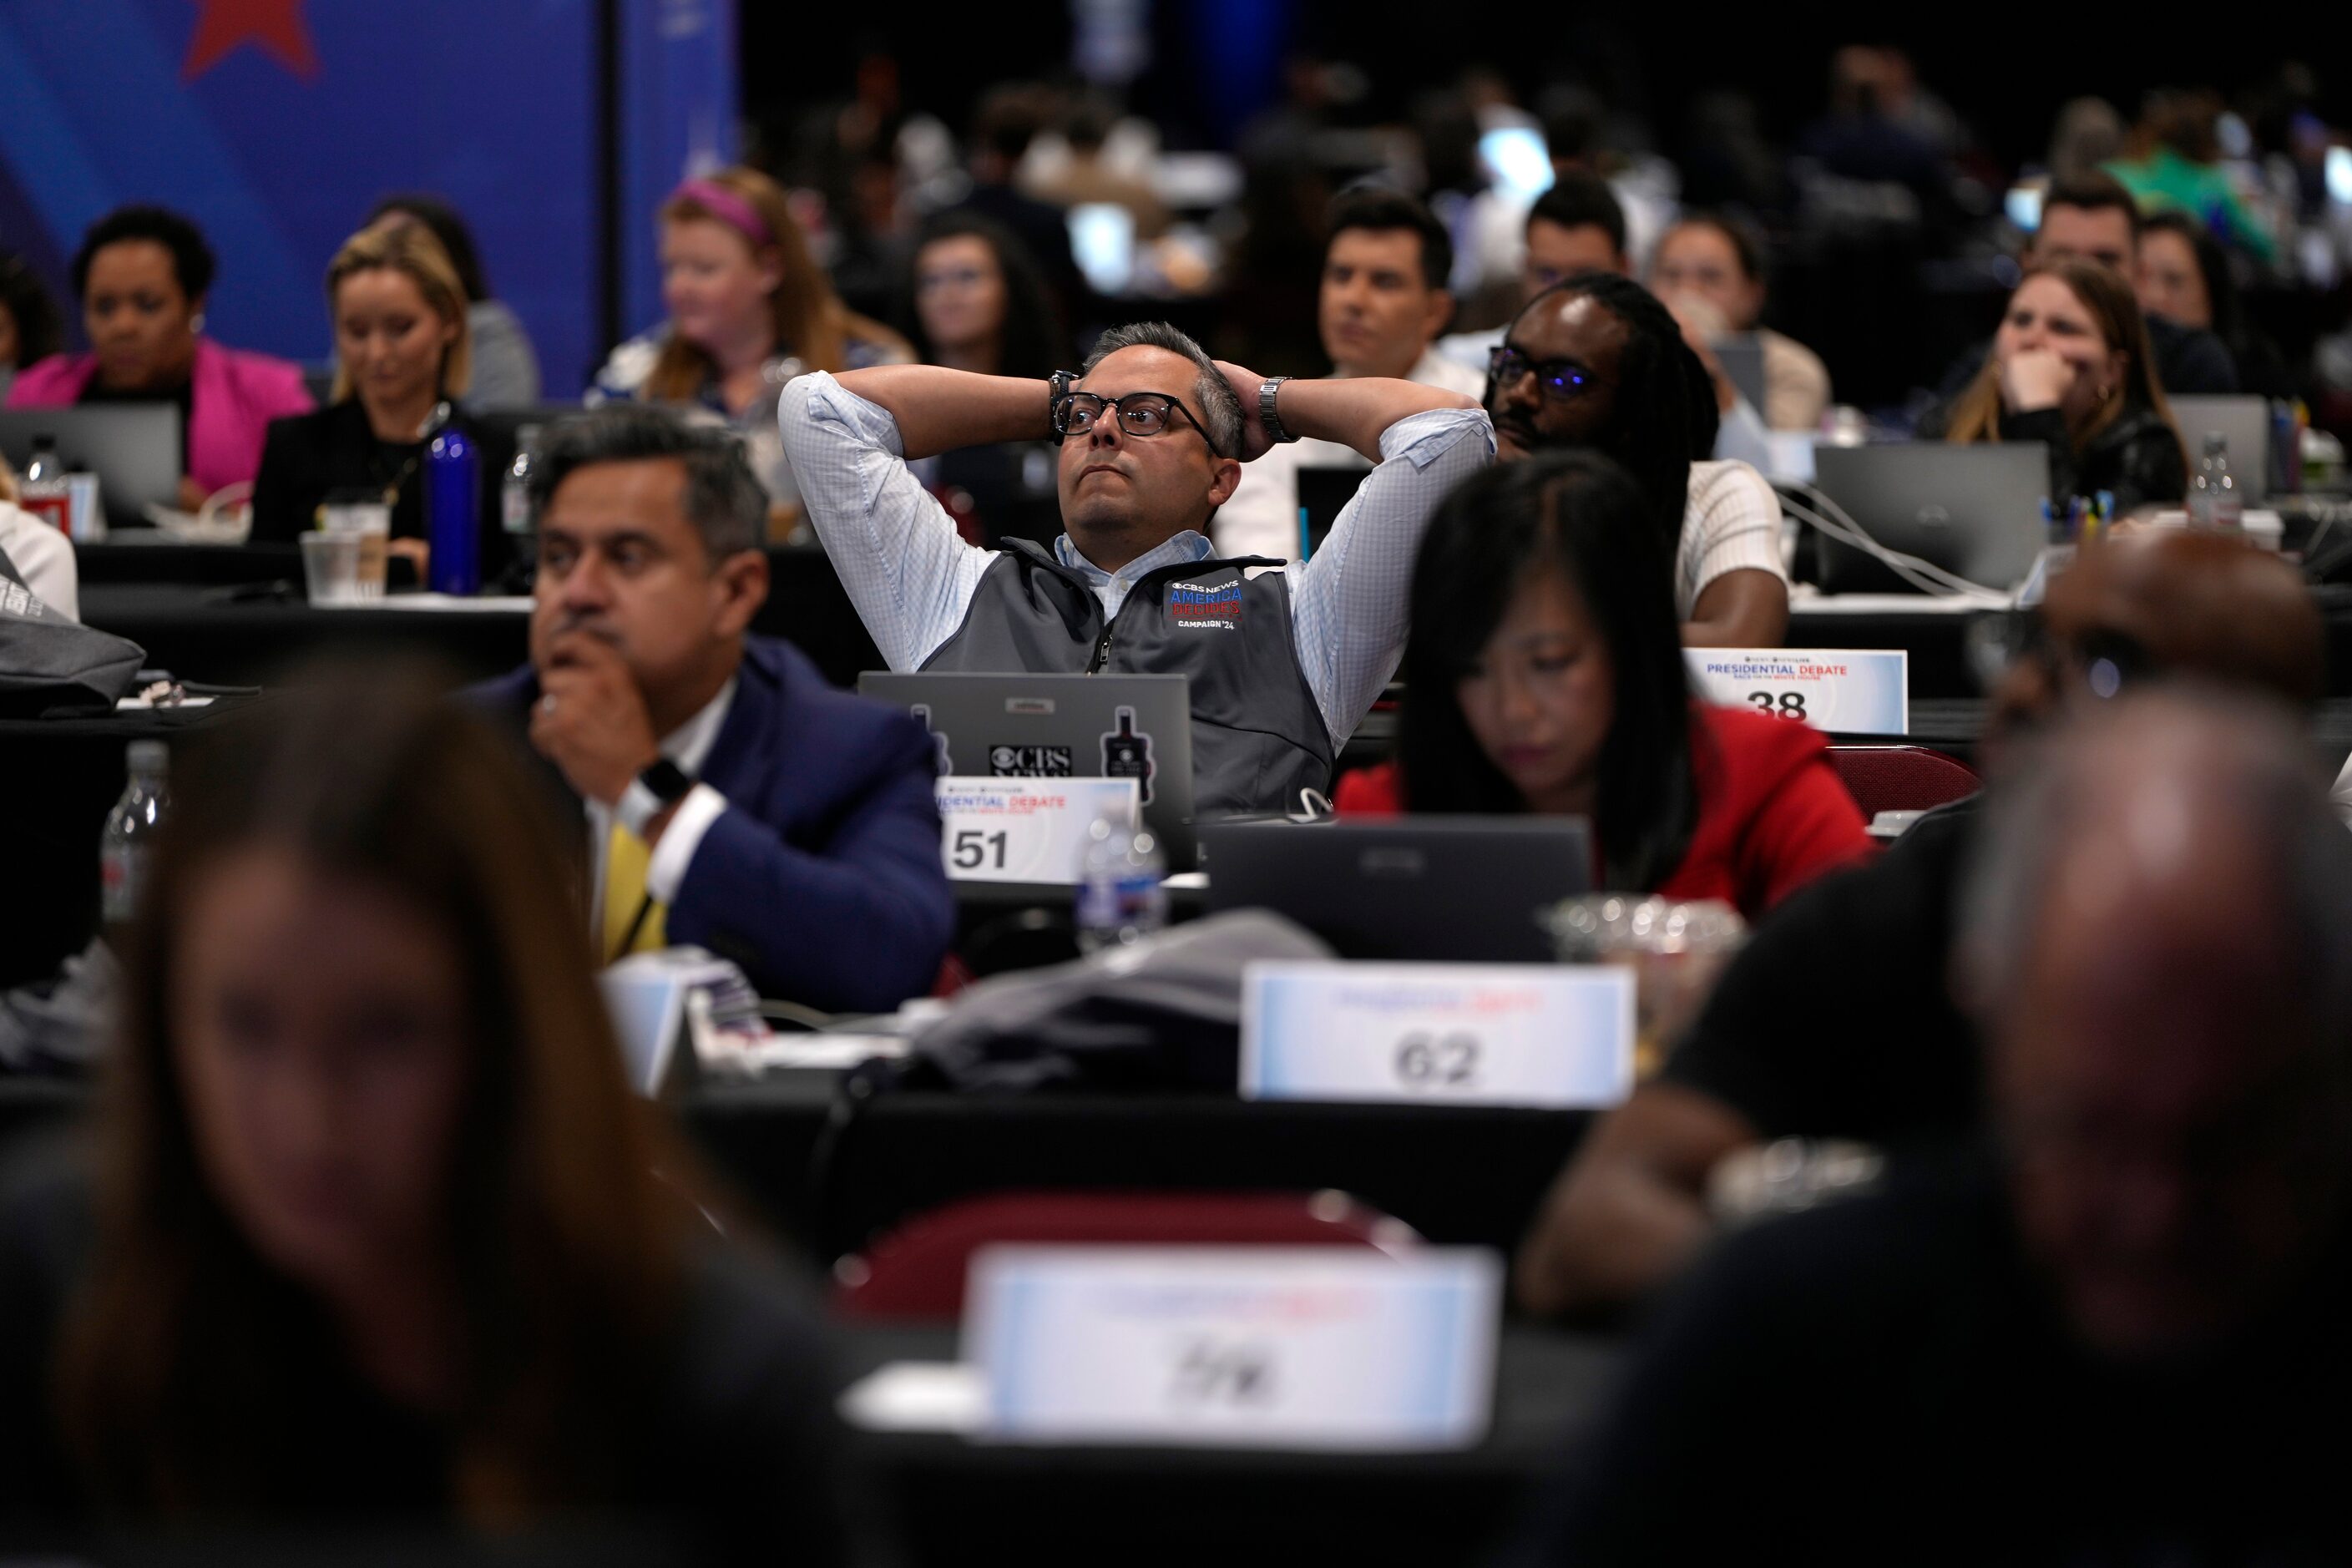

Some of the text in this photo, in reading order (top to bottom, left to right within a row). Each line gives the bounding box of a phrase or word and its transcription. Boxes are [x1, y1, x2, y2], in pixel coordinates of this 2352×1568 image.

[1182, 580, 1239, 593] CBS NEWS
[1171, 587, 1242, 604] AMERICA
[1172, 601, 1240, 615] DECIDES
[1222, 620, 1235, 630] '24
[1707, 664, 1848, 675] PRESIDENTIAL DEBATE
[1748, 690, 1808, 723] 38
[1015, 747, 1070, 768] CBS
[937, 796, 1065, 807] IDENTIAL DEBATE
[953, 831, 1007, 869] 51
[1394, 1032, 1480, 1085] 62
